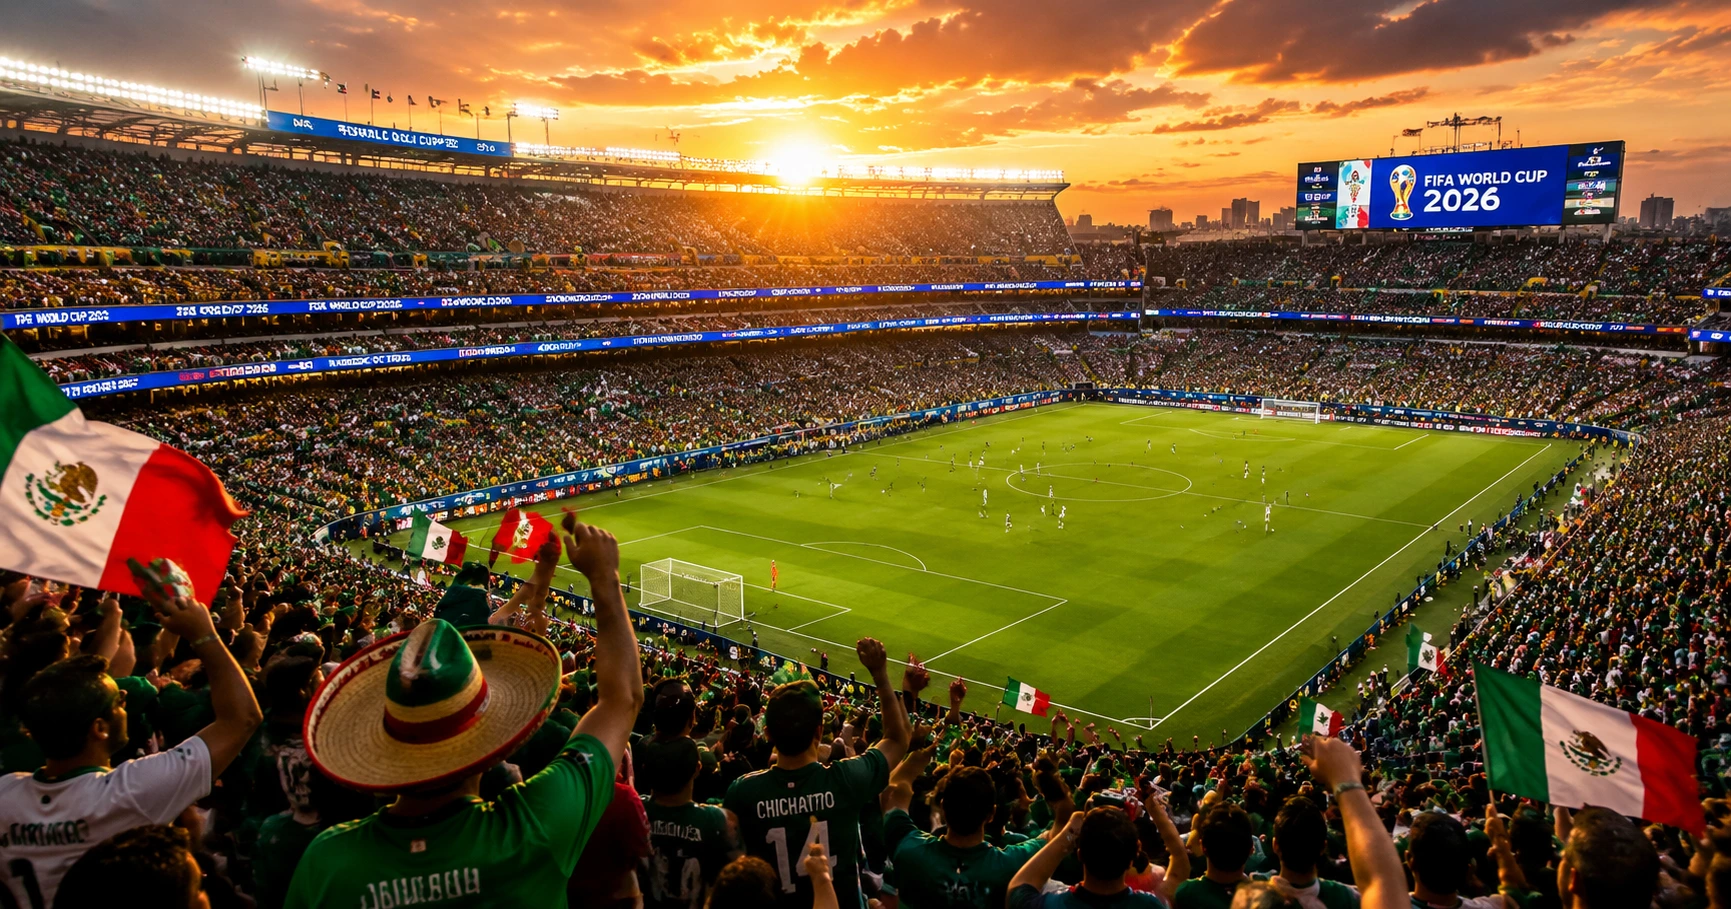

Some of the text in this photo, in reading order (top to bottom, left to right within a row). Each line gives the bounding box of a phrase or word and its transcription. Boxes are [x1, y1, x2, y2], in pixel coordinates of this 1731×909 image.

[1424, 169, 1548, 187] FIFA WORLD CUP
[1423, 186, 1501, 212] 2026
[765, 820, 838, 895] 14
